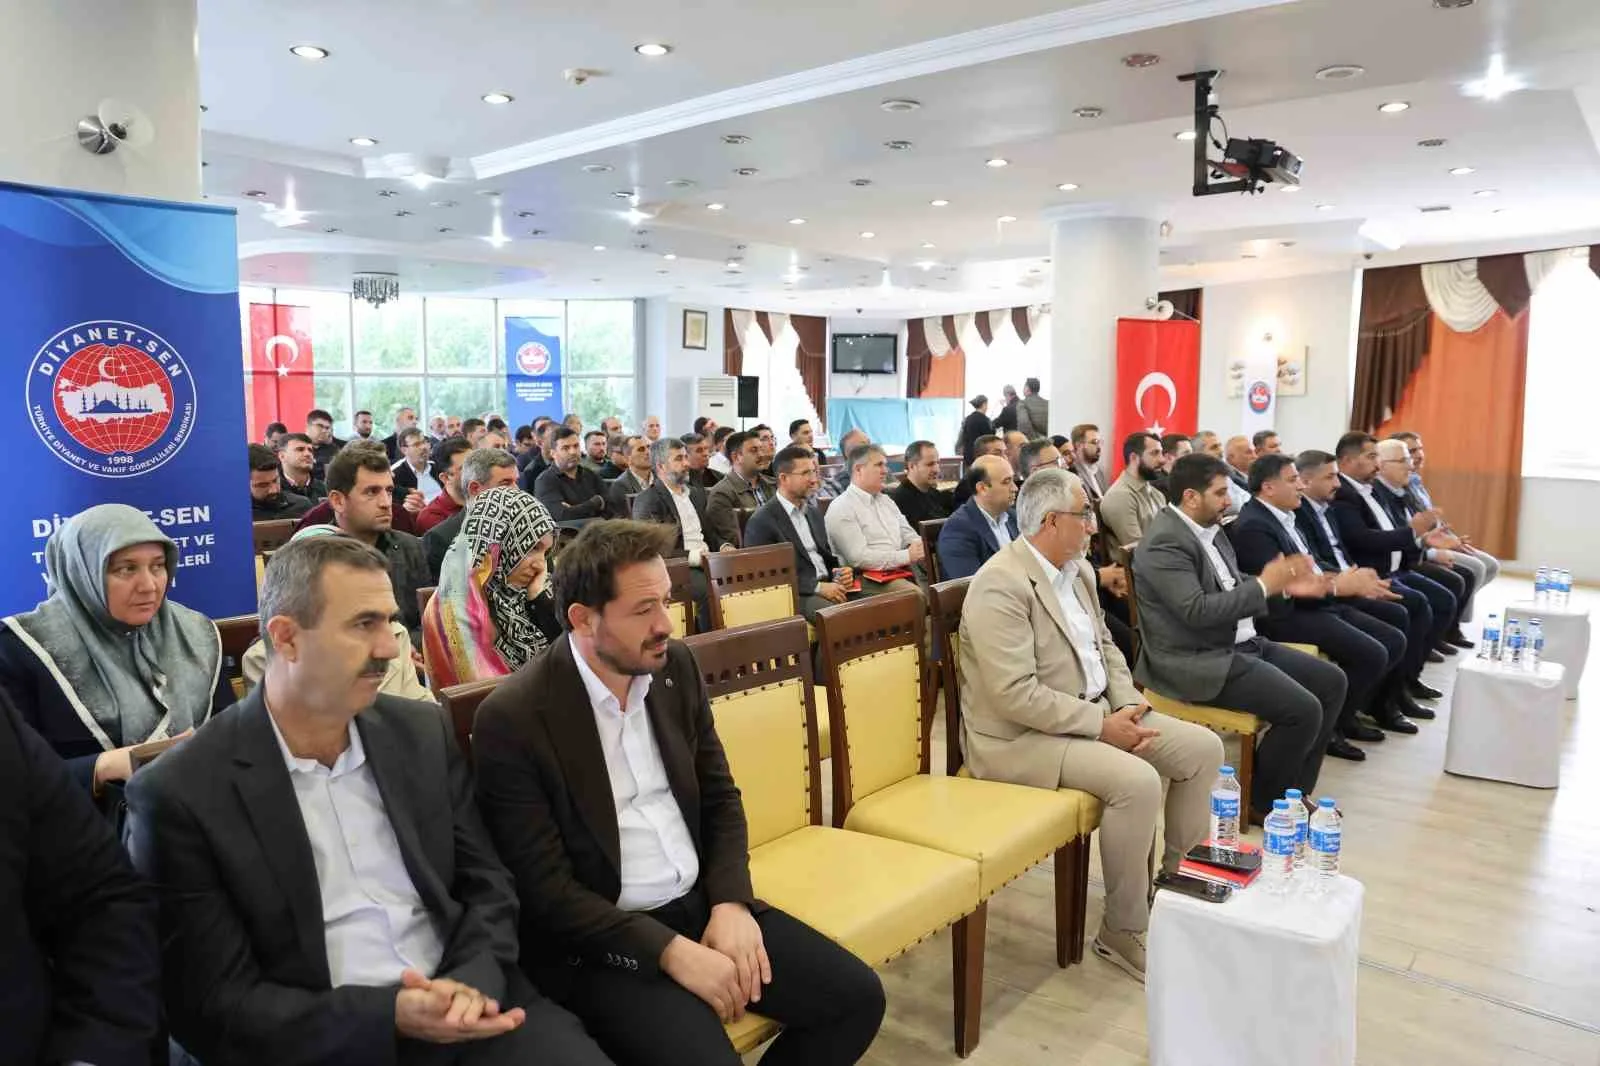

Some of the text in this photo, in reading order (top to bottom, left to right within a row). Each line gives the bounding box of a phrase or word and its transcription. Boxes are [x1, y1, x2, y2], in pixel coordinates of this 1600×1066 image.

[38, 327, 182, 377] DİYANET-SEN
[33, 404, 56, 440] TÜRKİYE
[53, 440, 87, 466] DİYANET
[88, 461, 100, 471] VE
[107, 455, 134, 465] 1998
[194, 534, 215, 546] VE
